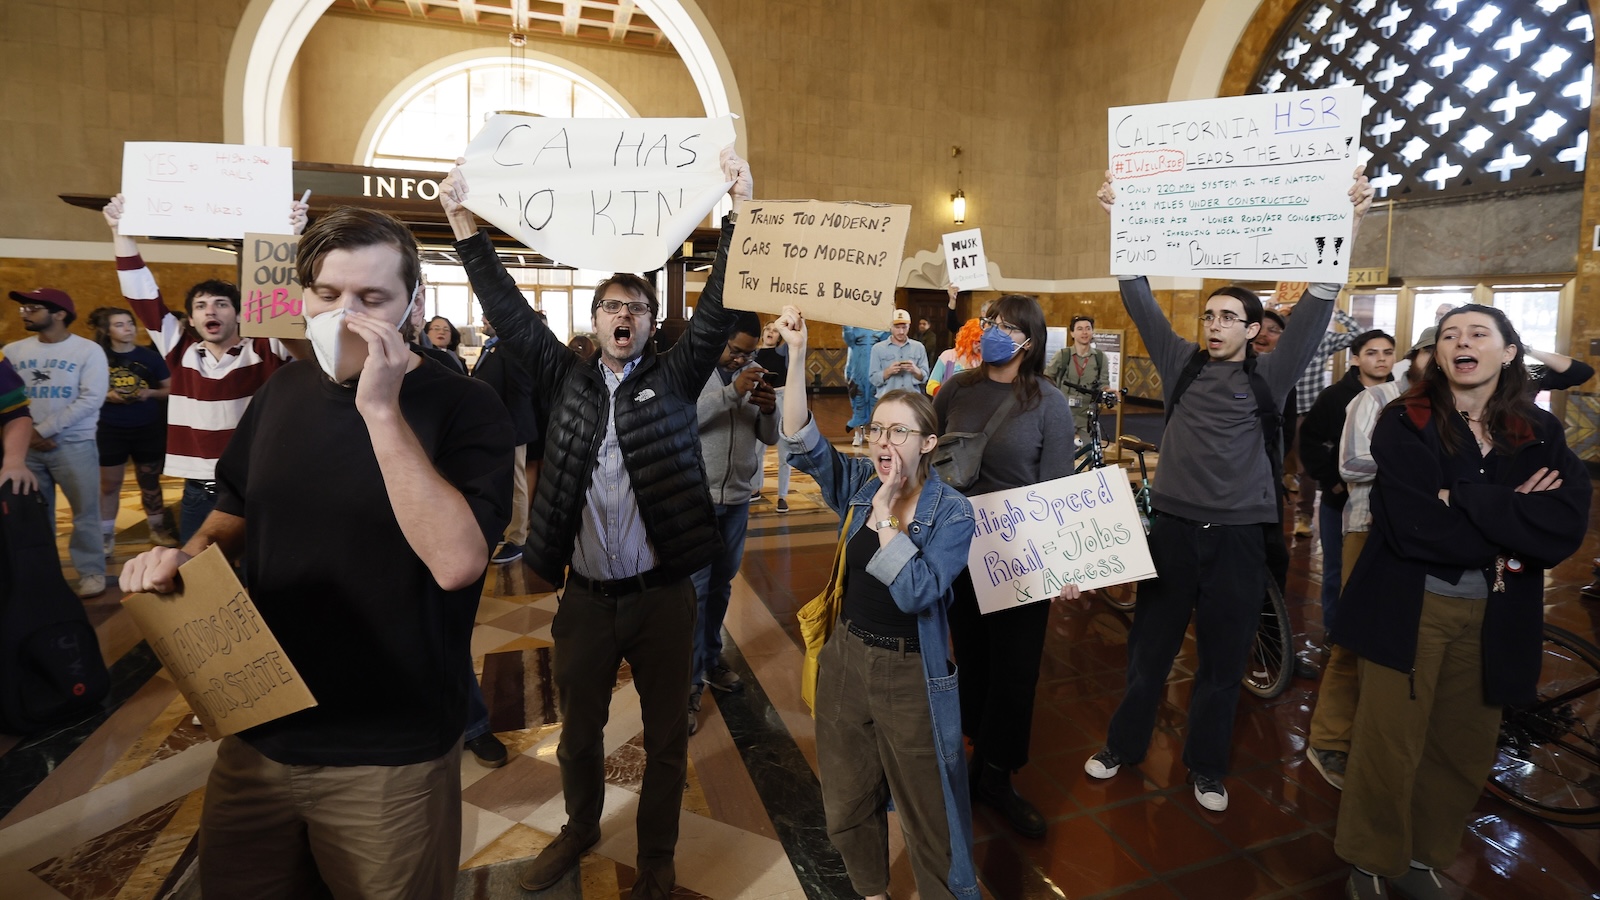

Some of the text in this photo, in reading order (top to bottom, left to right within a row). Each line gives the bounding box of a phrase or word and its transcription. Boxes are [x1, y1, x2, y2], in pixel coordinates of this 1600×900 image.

[1115, 96, 1341, 149] CALIFORNIA HSR
[492, 124, 701, 169] CA HAS
[1186, 149, 1235, 166] LEADS
[1243, 145, 1280, 162] THE
[144, 153, 178, 176] YES
[362, 175, 440, 201] INFO
[1126, 175, 1326, 194] ONLY 220 MPH SYSTEM IN THE NATION
[147, 198, 173, 213] NO
[1154, 200, 1184, 210] MILES
[1189, 199, 1220, 208] UNDER
[1227, 195, 1310, 206] CONSTRUCTION
[750, 207, 891, 233] TRAINS TOO MODERN?
[1128, 215, 1187, 225] CLEANER AIR
[1208, 213, 1347, 224] LOWER ROAD/AIR CONGESTION
[1116, 230, 1151, 243] FULLY
[1166, 229, 1211, 237] IMPROVING
[1243, 226, 1273, 234] INFRA
[742, 237, 888, 268] CARS TOO MODERN?
[951, 238, 978, 251] MUSK
[1115, 249, 1157, 264] FUND
[1188, 240, 1241, 266] BULLET
[1248, 233, 1308, 265] TRAIN
[952, 254, 978, 270] RAT
[253, 265, 302, 286] OUR
[738, 270, 883, 306] TRY HORSE & BUGGY
[43, 359, 77, 373] JOSE
[974, 471, 1115, 543] High Speed
[983, 538, 1045, 588] Rail
[1057, 517, 1131, 561] Jobs
[1013, 554, 1126, 603] & Access
